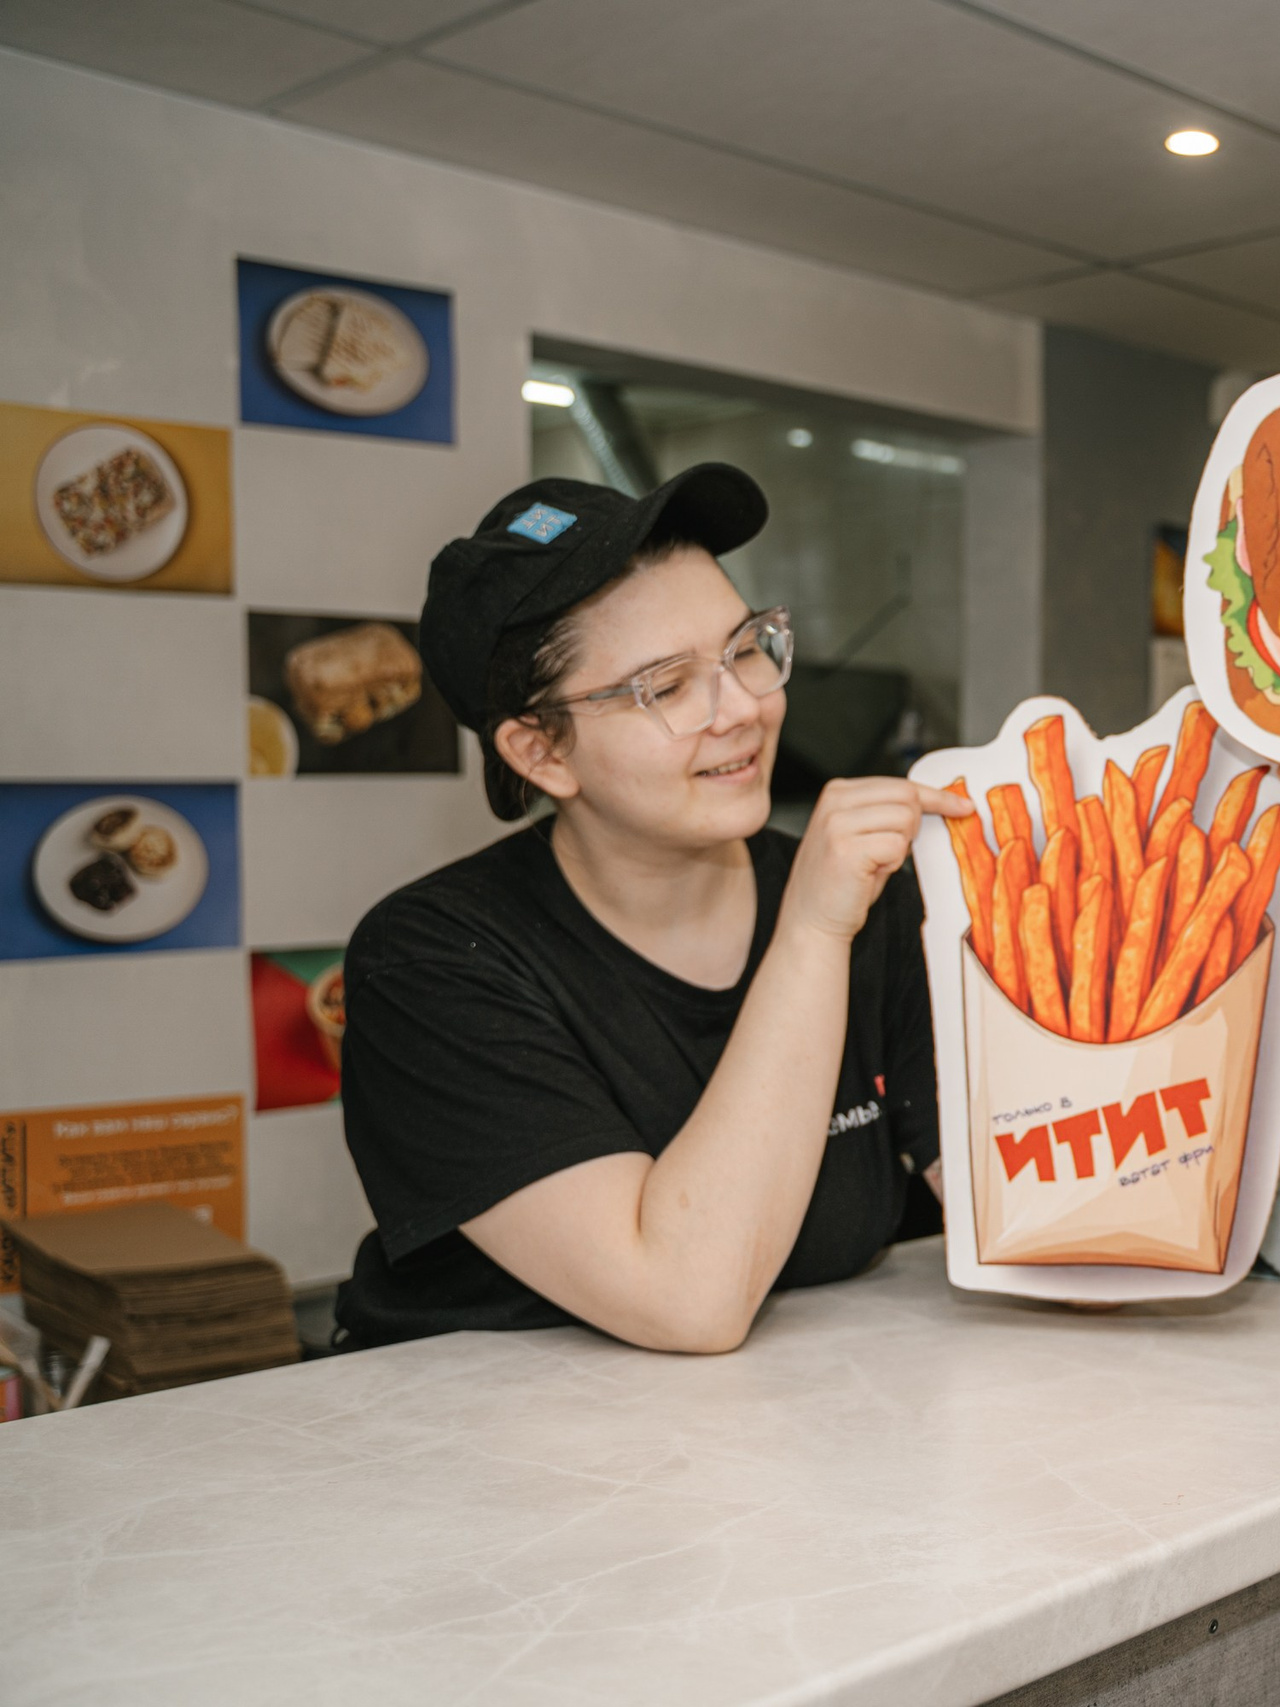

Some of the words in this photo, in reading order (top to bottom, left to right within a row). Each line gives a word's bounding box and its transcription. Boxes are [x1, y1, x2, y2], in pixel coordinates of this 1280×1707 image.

[992, 1101, 1052, 1125] только
[994, 1077, 1212, 1183] ИТИТ
[1178, 1144, 1215, 1168] фри
